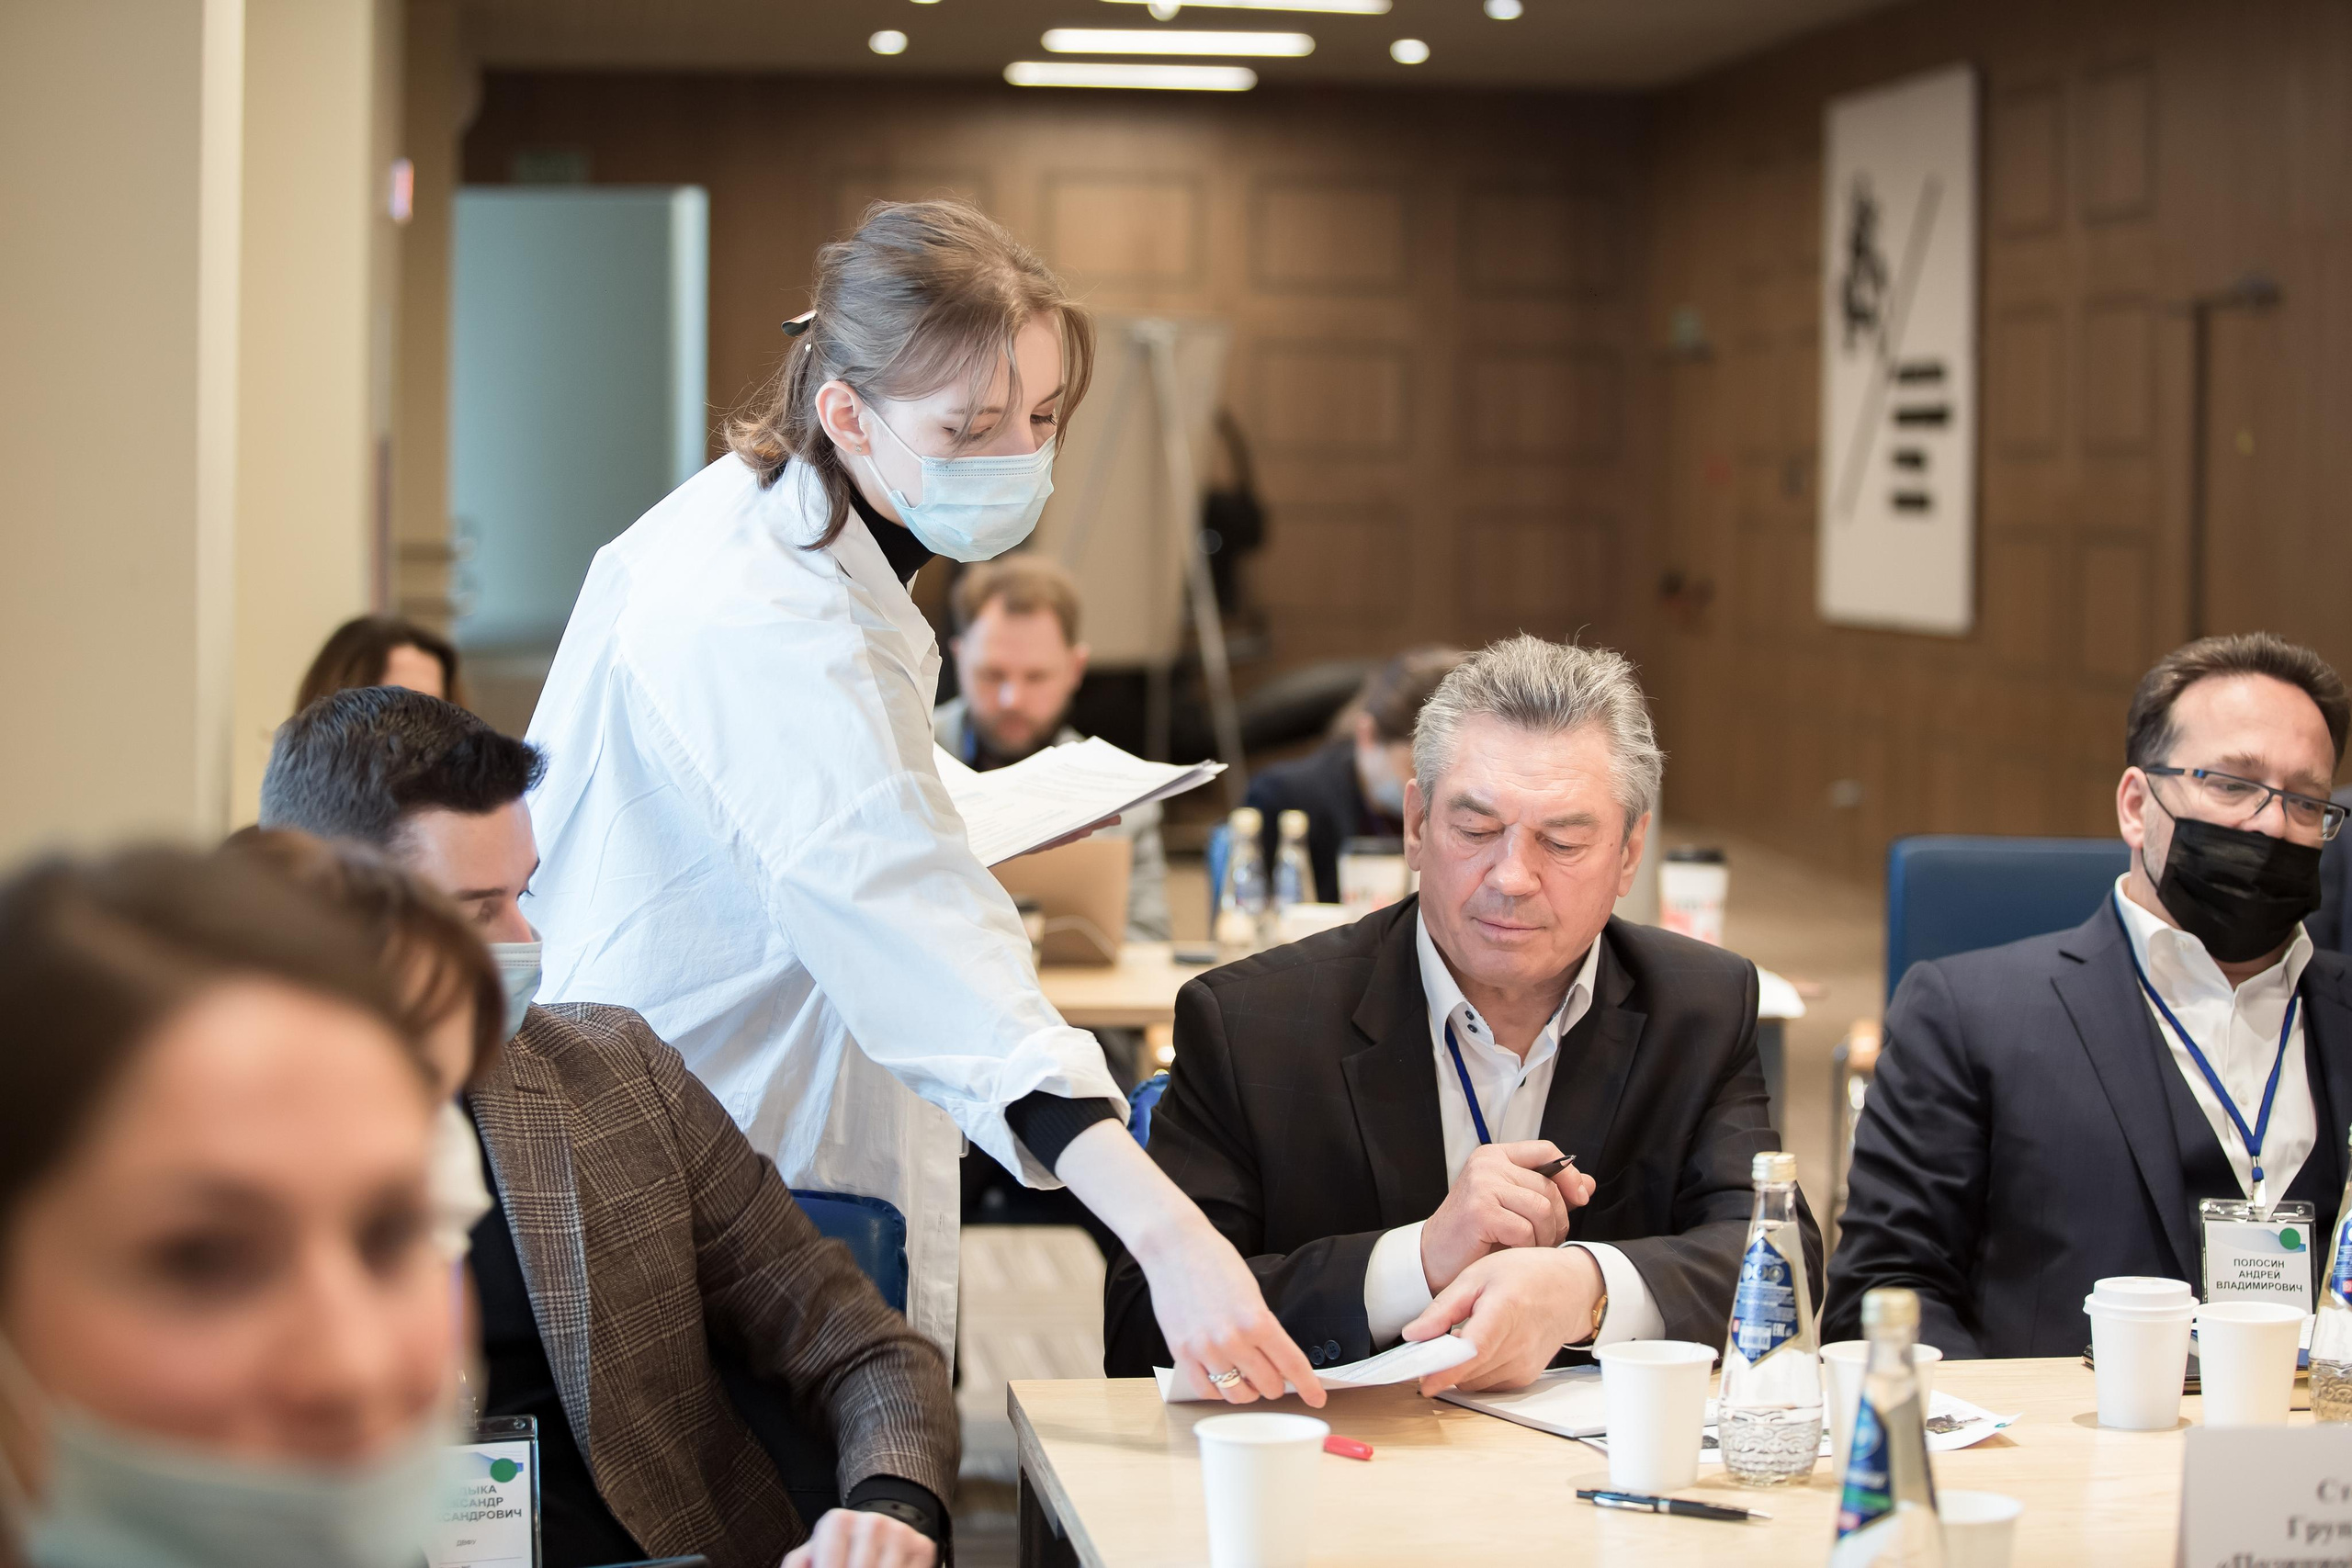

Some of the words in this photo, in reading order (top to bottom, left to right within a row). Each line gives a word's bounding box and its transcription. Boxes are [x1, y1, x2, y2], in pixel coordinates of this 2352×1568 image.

[2233, 1258, 2285, 1269] ПОЛОСИН
[2238, 1269, 2280, 1280] АНДРЕЙ
[2216, 1280, 2302, 1292] ВЛАДИМИРОВИЧ
[439, 1508, 522, 1522] САНДРОВИЧ
